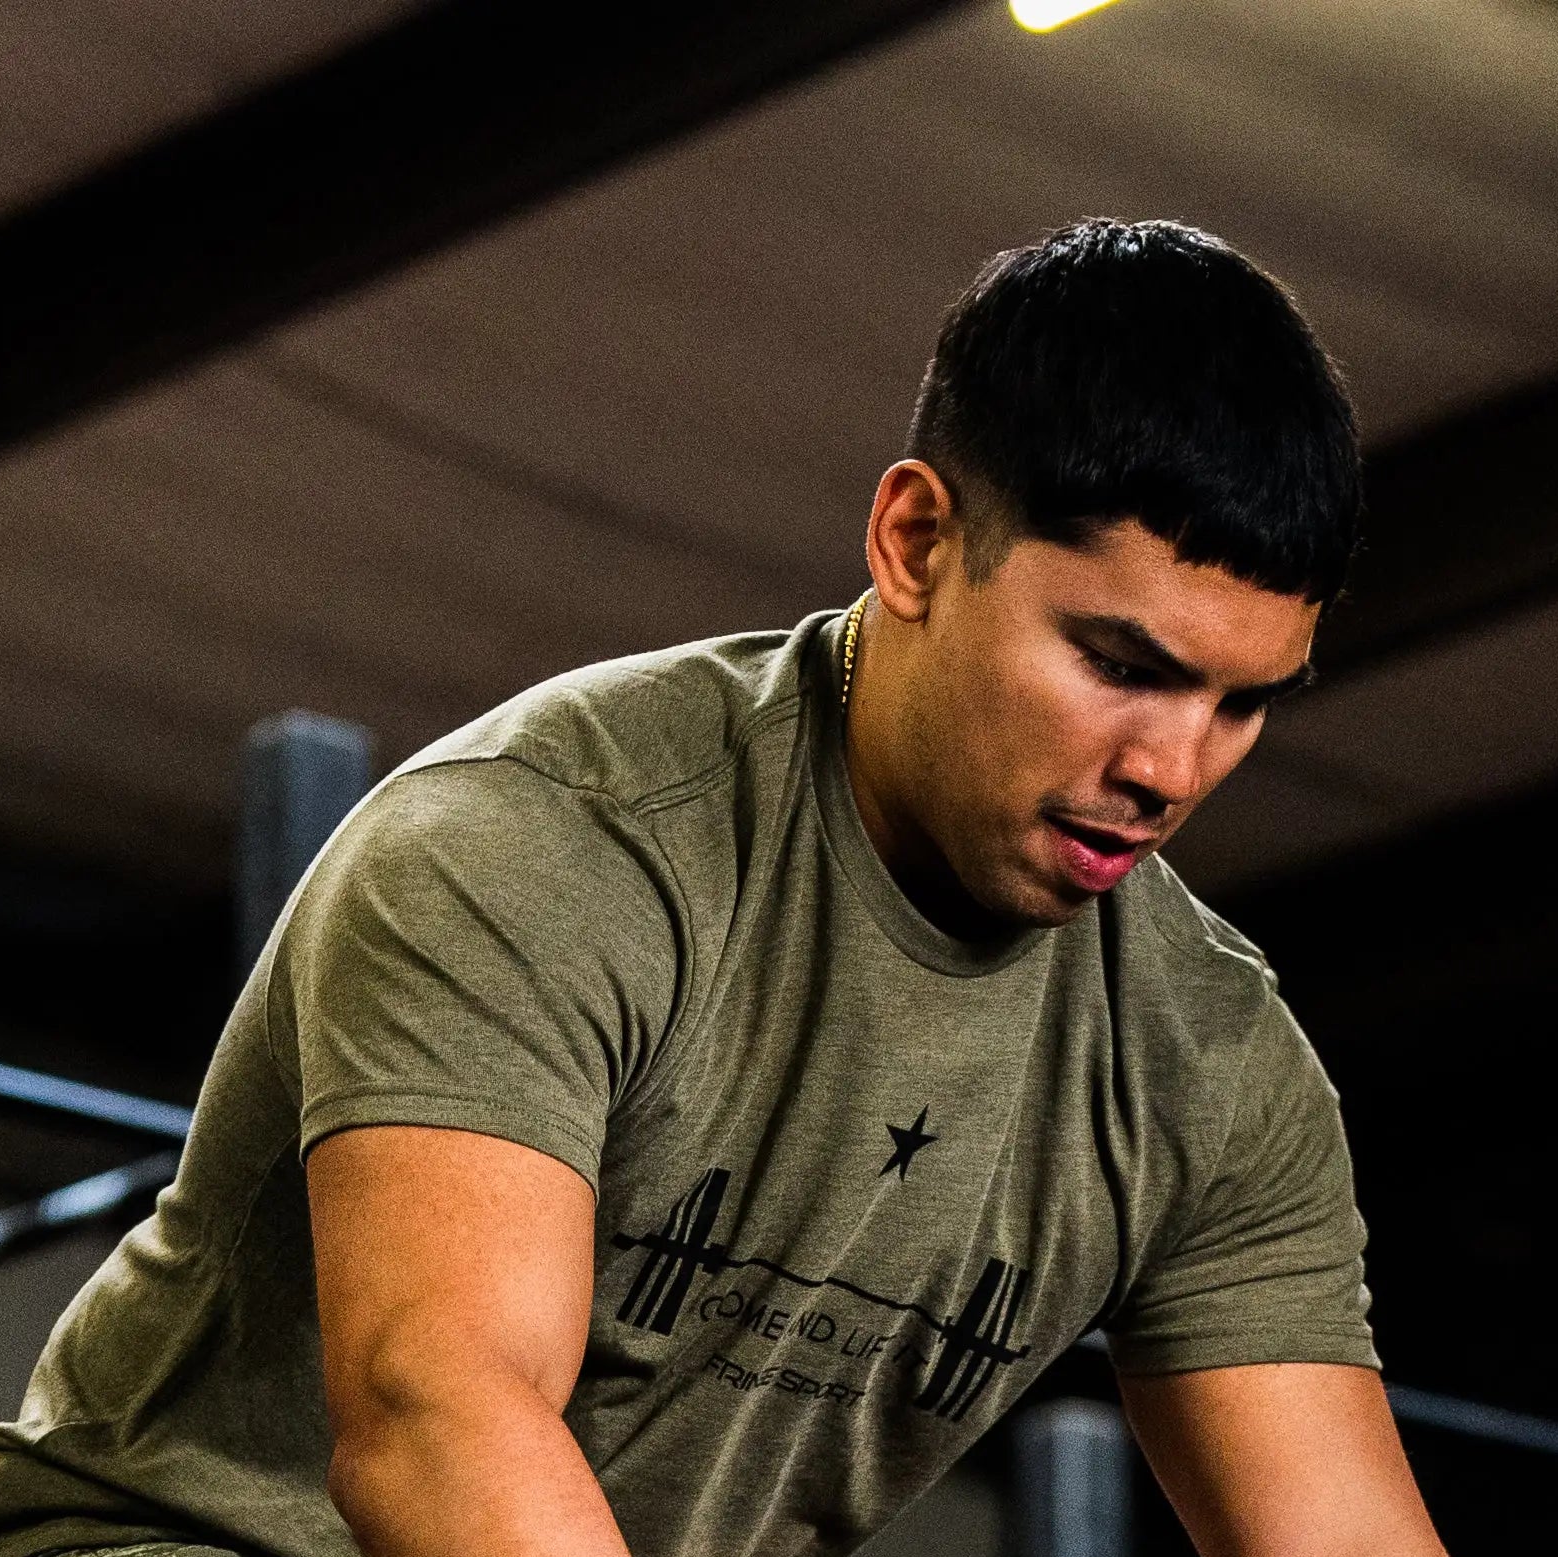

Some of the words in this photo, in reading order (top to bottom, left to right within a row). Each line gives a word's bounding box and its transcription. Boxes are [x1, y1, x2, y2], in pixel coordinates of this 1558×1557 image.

[700, 1290, 790, 1341] COME
[787, 1310, 836, 1343] ND
[841, 1328, 897, 1358] LIF
